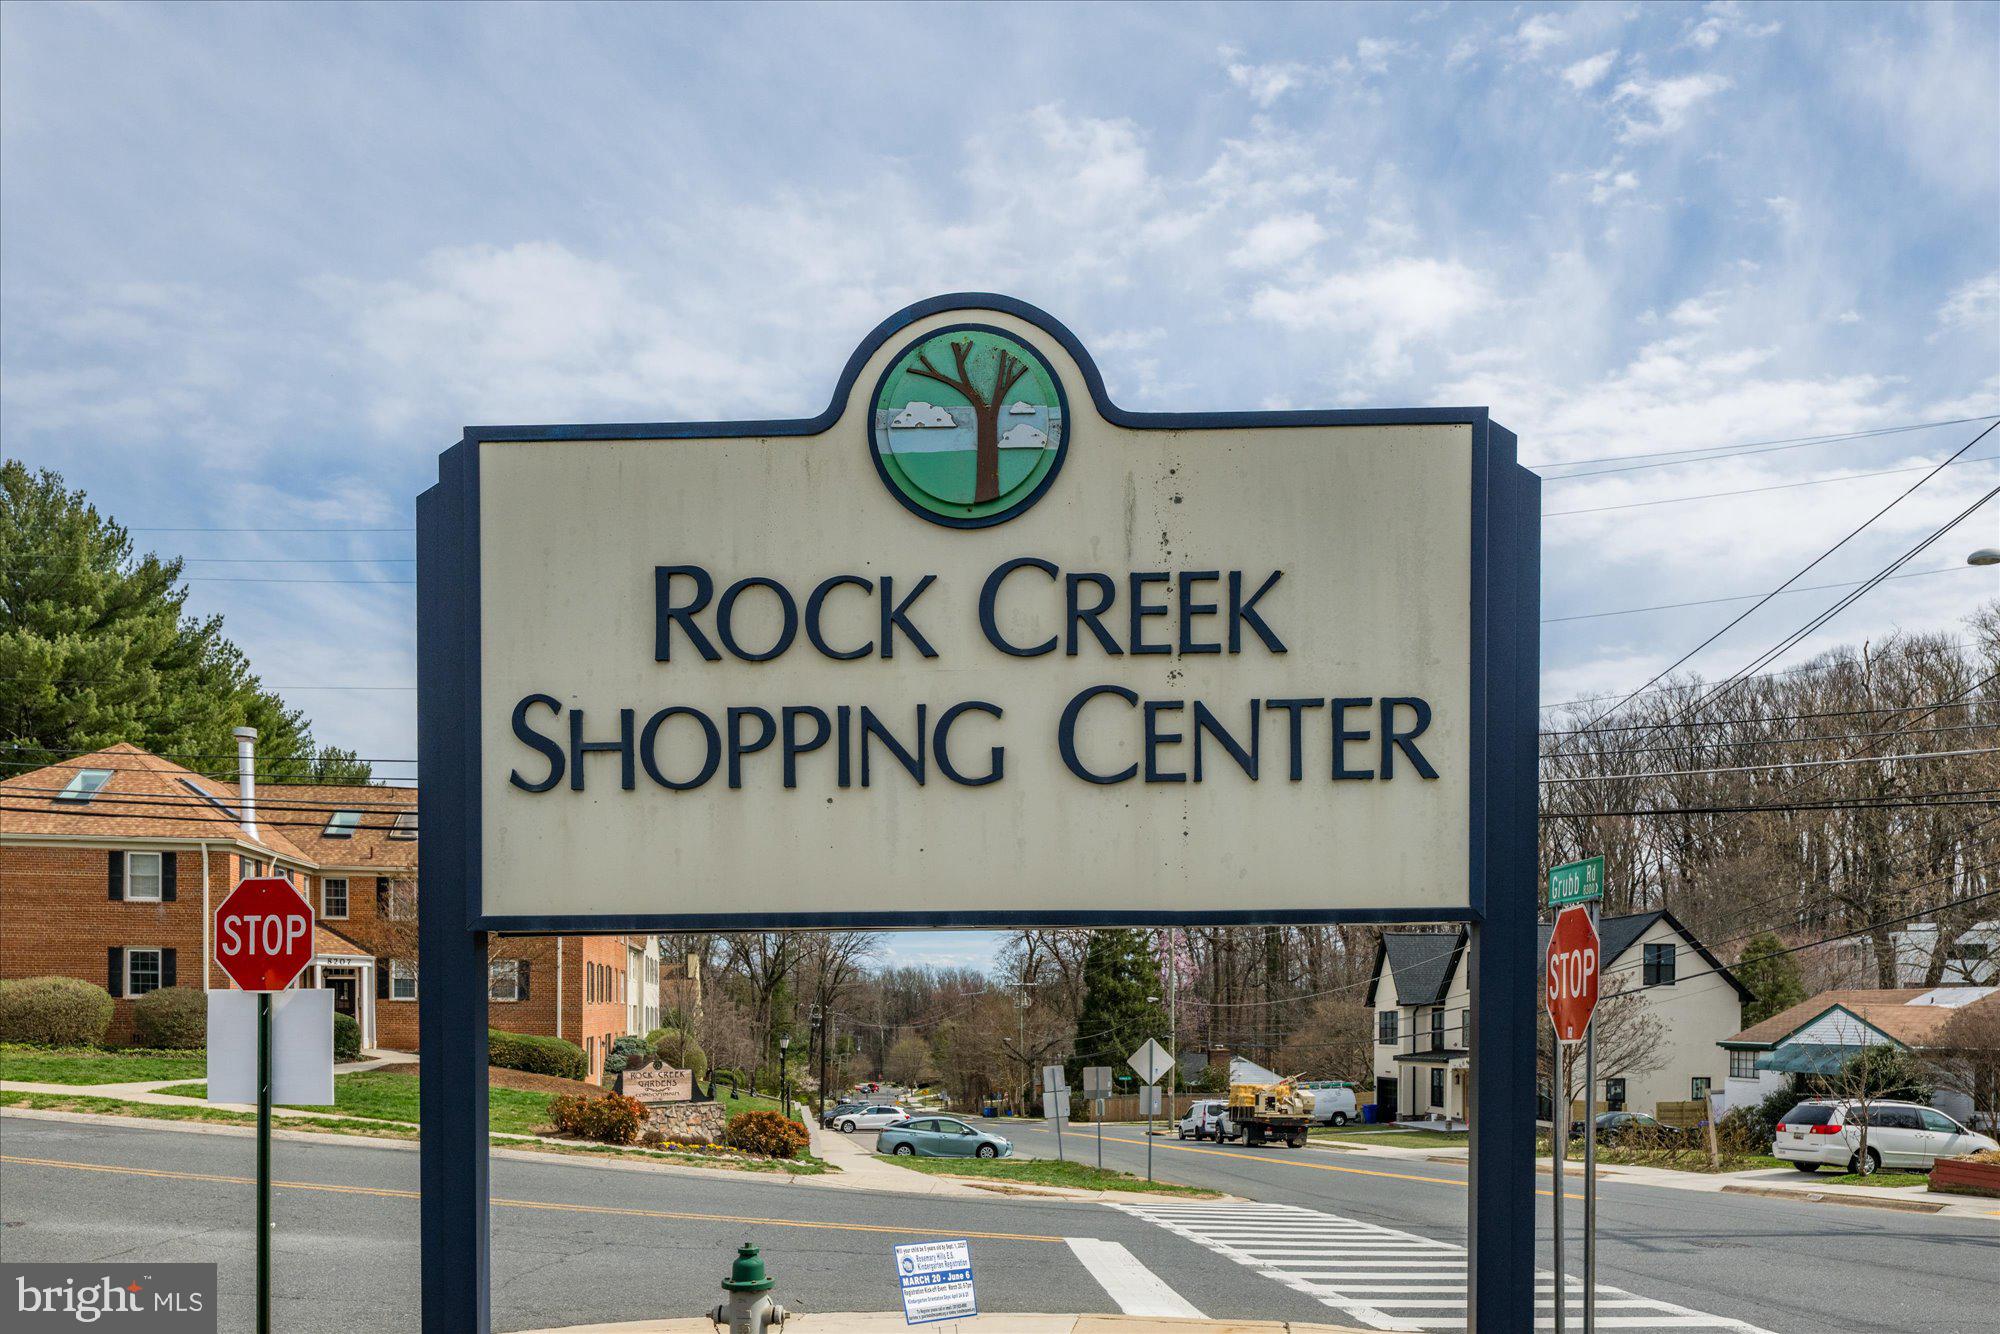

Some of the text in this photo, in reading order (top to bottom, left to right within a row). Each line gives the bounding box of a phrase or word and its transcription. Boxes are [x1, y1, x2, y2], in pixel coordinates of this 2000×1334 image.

[655, 557, 1288, 662] ROCK CREEK
[509, 684, 1440, 793] SHOPPING CENTER
[1552, 864, 1596, 899] Grubb Rd
[222, 914, 307, 956] STOP
[327, 957, 352, 965] 8207
[1549, 948, 1596, 1000] STOP
[630, 1070, 685, 1080] ROCK CREEK
[638, 1080, 677, 1088] GARDENS
[916, 1254, 937, 1262] Rosemary
[937, 1252, 946, 1260] Hills
[917, 1259, 968, 1271] Kindergarten Registration
[902, 1274, 931, 1287] MARCH
[932, 1273, 941, 1283] 20
[947, 1272, 964, 1281] June
[965, 1270, 971, 1279] 6
[904, 1288, 924, 1297] Registration
